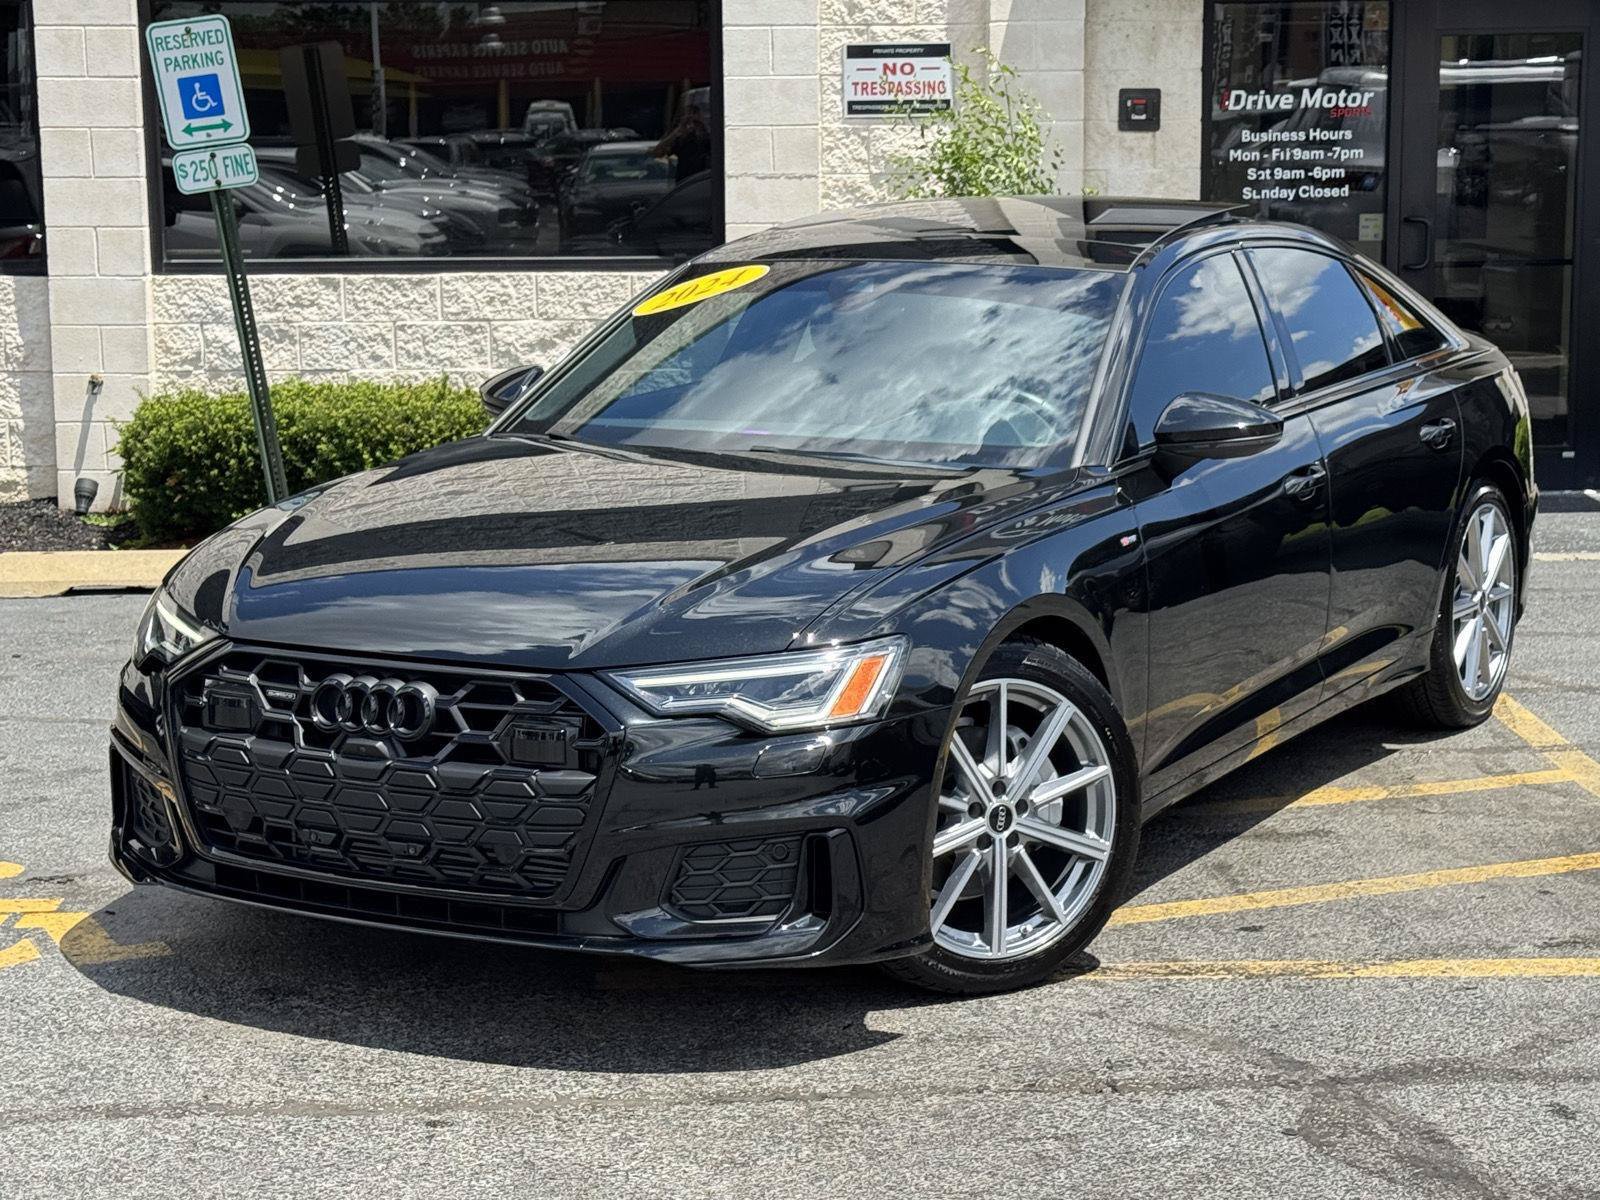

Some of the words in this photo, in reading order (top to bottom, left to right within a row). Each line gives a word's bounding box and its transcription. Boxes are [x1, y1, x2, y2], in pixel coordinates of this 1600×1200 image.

[155, 29, 224, 52] RESERVED
[164, 50, 224, 72] PARKING
[882, 62, 915, 76] NO
[851, 80, 946, 96] TRESPASSING
[1300, 88, 1374, 109] Motor
[1241, 129, 1306, 143] Business
[1309, 128, 1353, 141] Hours
[1229, 149, 1260, 162] Mon
[178, 158, 219, 182] $250
[222, 153, 254, 178] FINE
[1274, 167, 1305, 180] 9am
[1298, 184, 1350, 198] Closed
[651, 269, 747, 310] 2024
